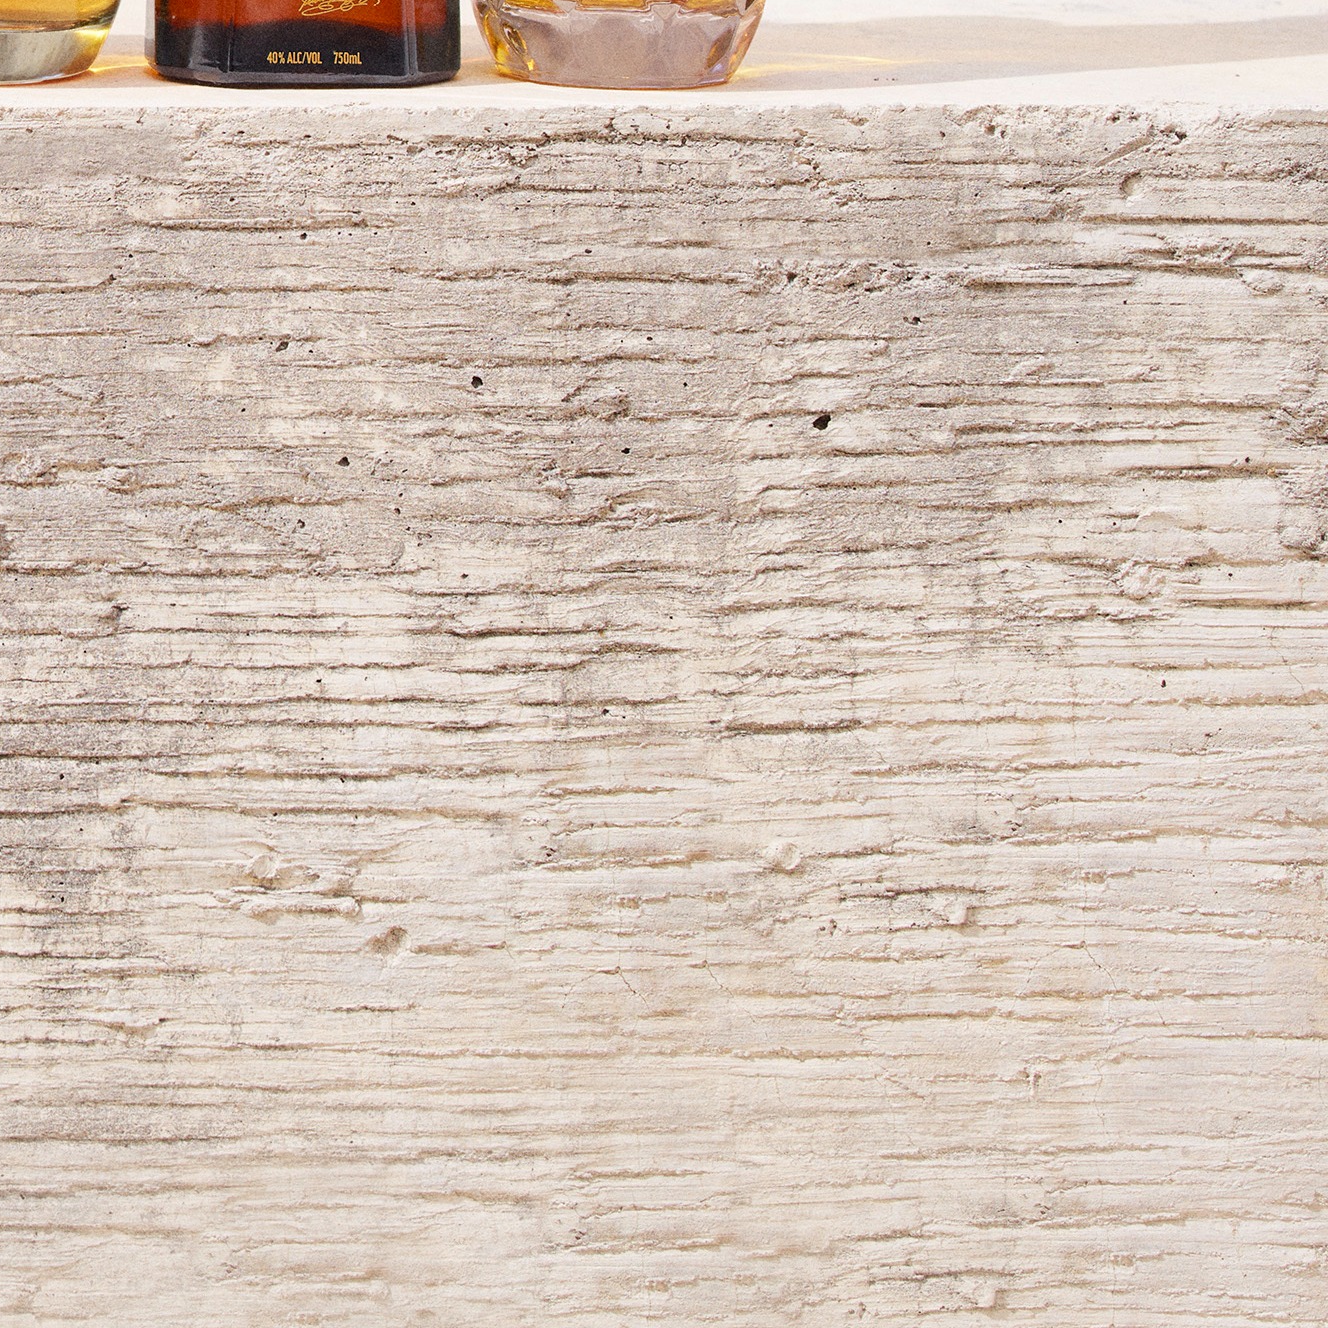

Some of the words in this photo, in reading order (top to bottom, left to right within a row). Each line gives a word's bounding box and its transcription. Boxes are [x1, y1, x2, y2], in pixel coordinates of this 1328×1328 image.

[266, 51, 286, 65] 40%
[286, 51, 323, 65] ALC/VOL
[333, 51, 363, 65] 750mL
